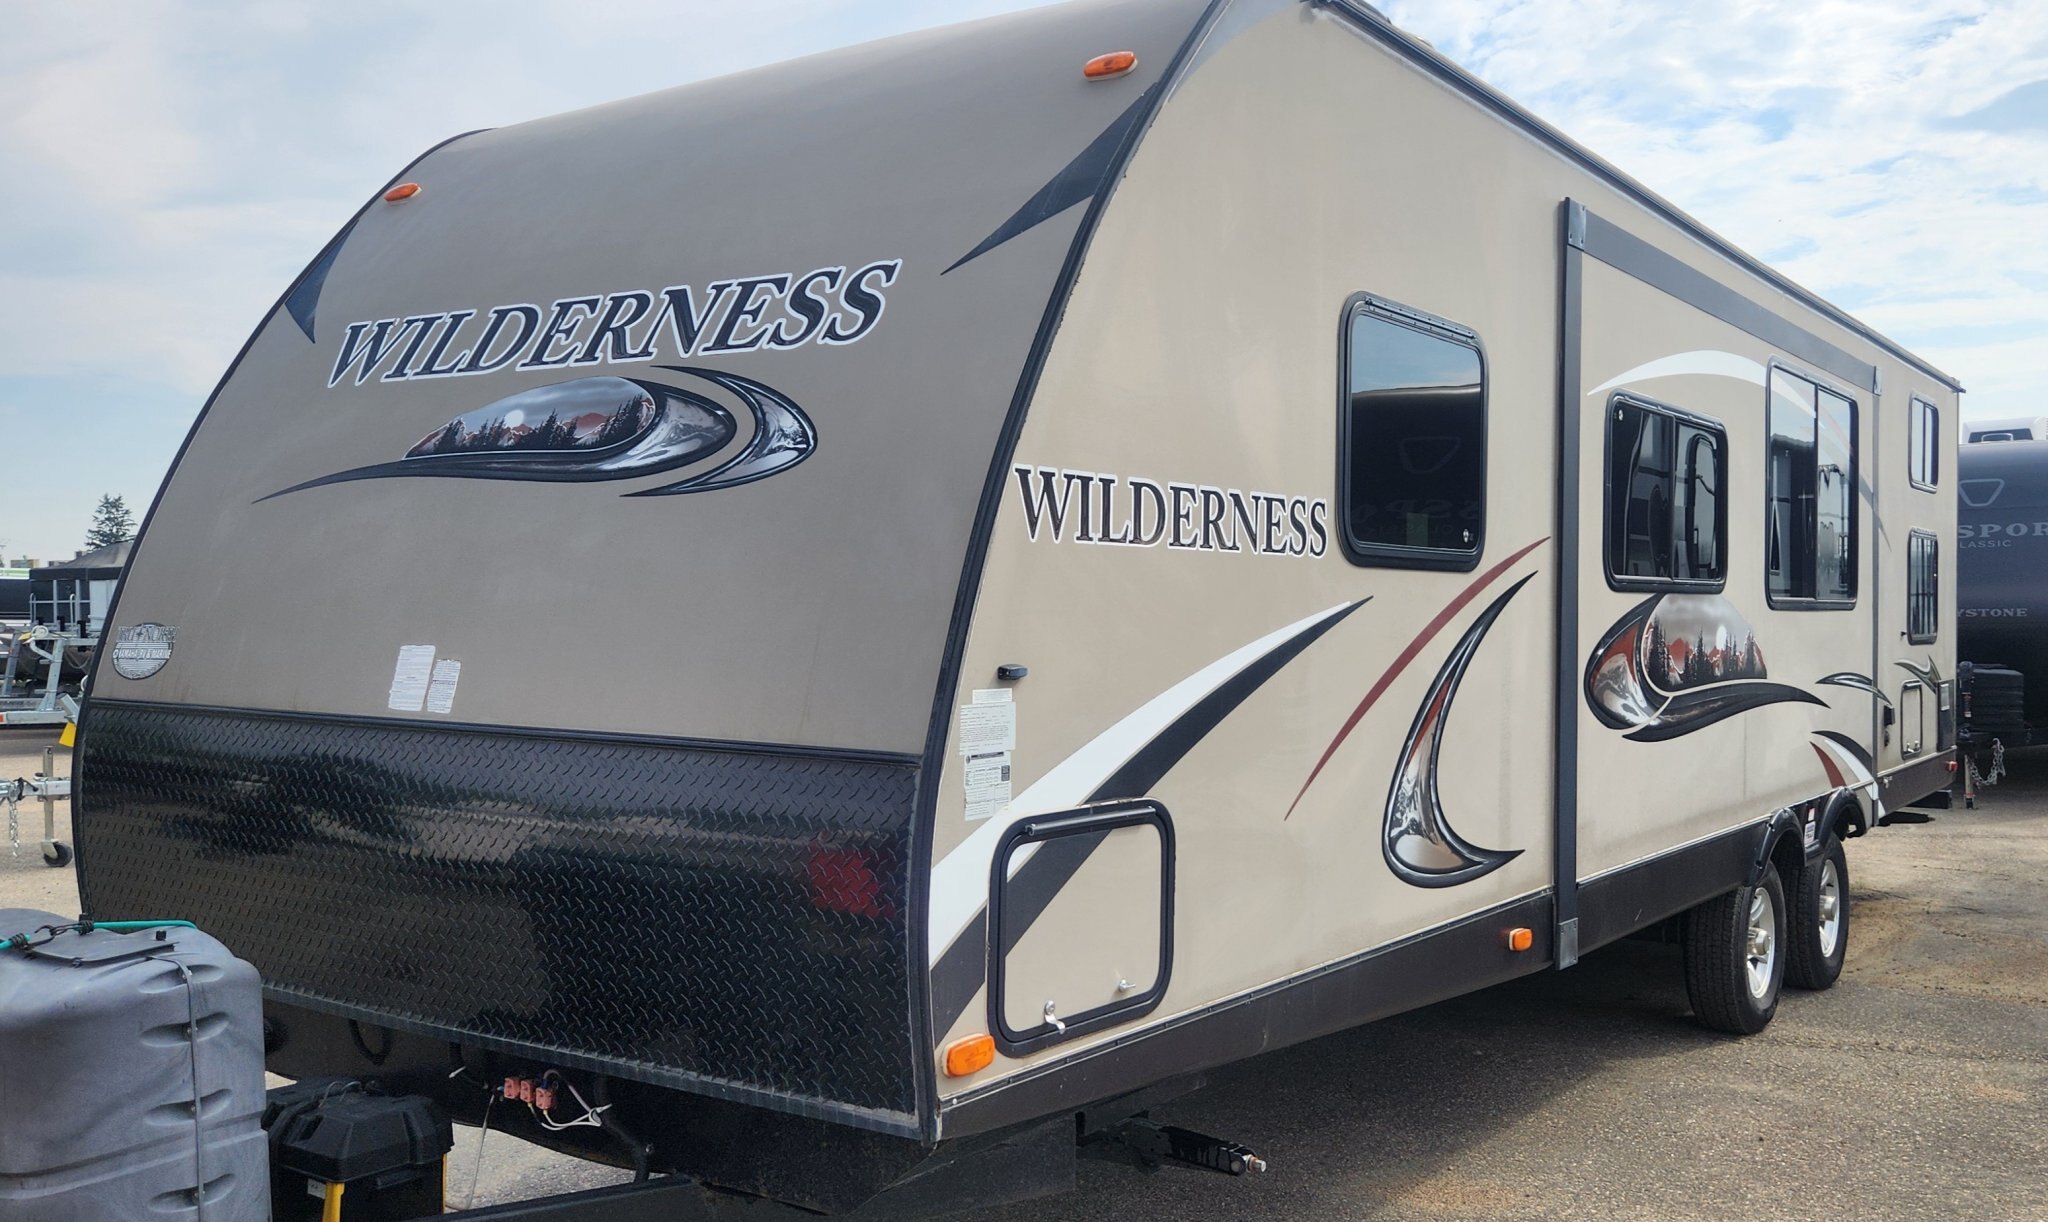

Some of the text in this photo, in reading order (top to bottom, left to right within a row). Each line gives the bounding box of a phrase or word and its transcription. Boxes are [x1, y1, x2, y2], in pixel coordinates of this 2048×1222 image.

[326, 258, 903, 388] WILDERNESS
[1012, 463, 1328, 558] WILDERNESS
[1958, 522, 2048, 538] SPOR
